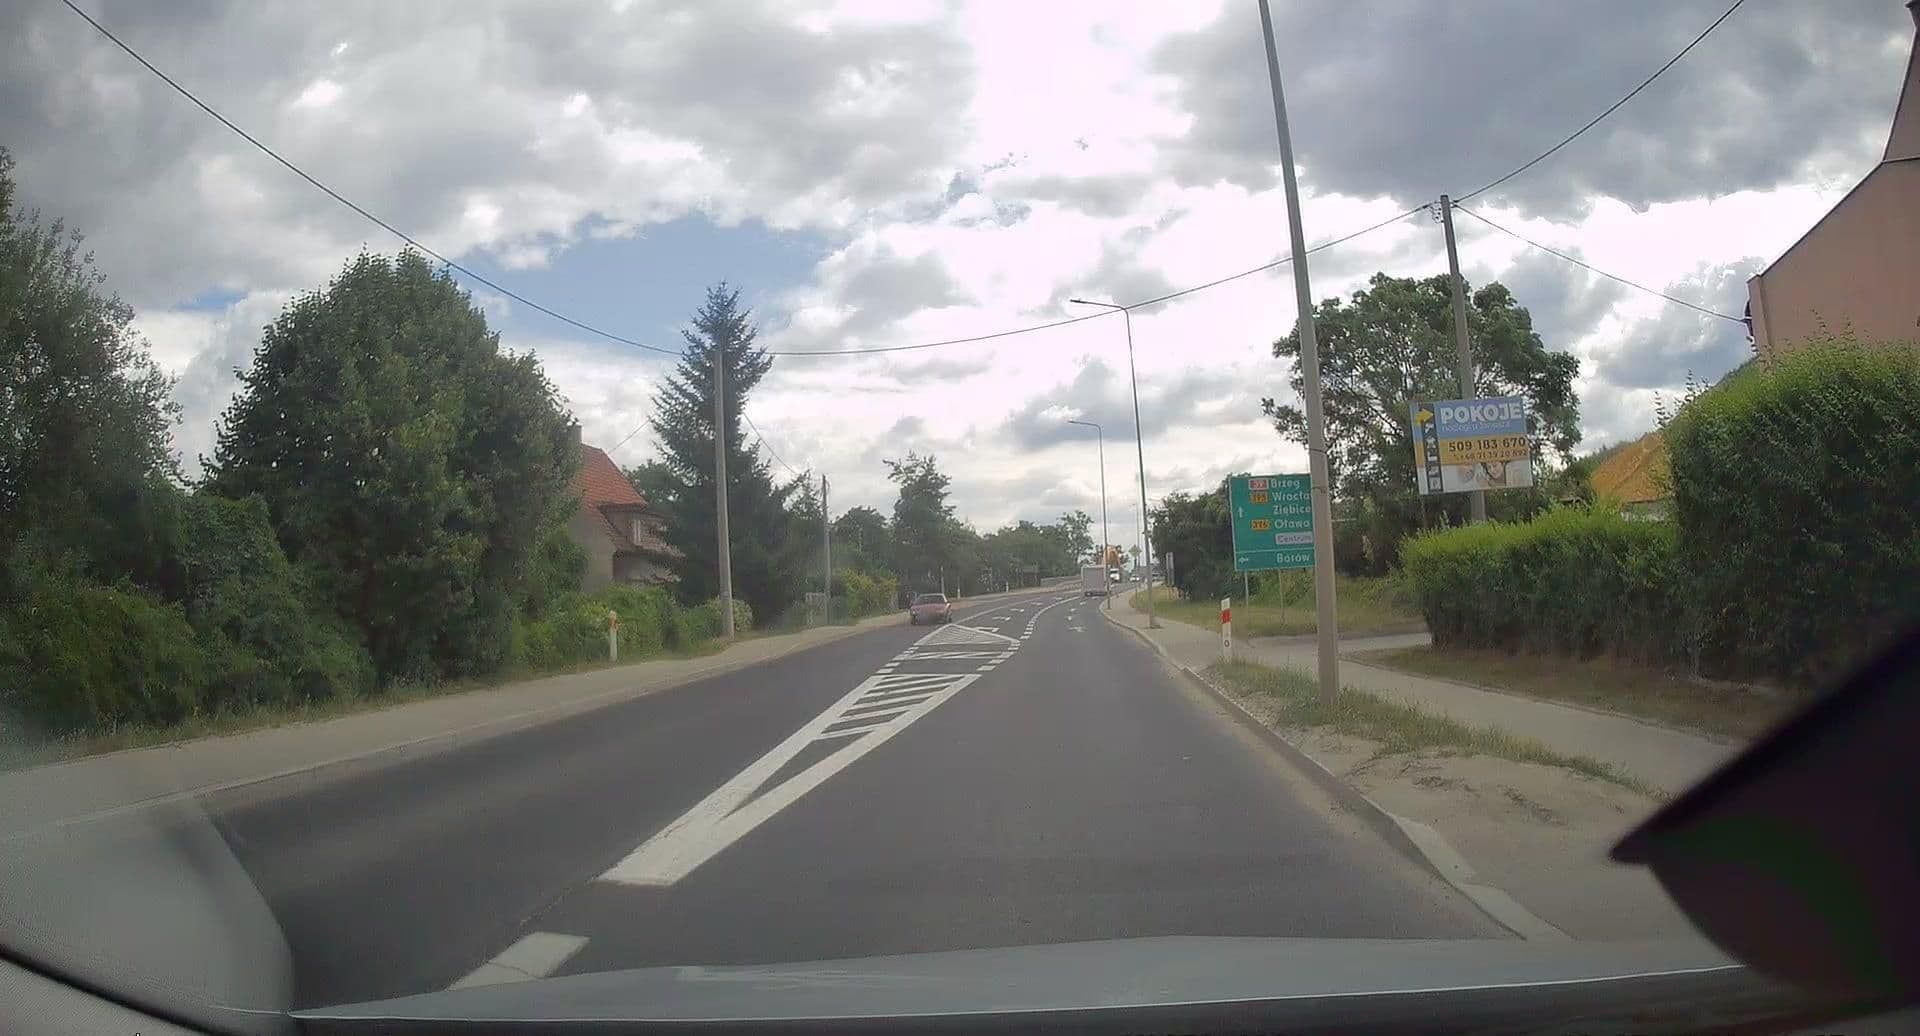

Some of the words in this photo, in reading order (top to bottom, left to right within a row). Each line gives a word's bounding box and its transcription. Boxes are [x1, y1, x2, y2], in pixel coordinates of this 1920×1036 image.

[1440, 403, 1522, 424] POKOJE
[1449, 440, 1472, 452] 509
[1478, 439, 1497, 450] 183
[1502, 437, 1526, 448] 670
[1270, 479, 1300, 490] Brzeg
[1272, 491, 1312, 502] Wrocła
[1276, 553, 1310, 564] Borów
